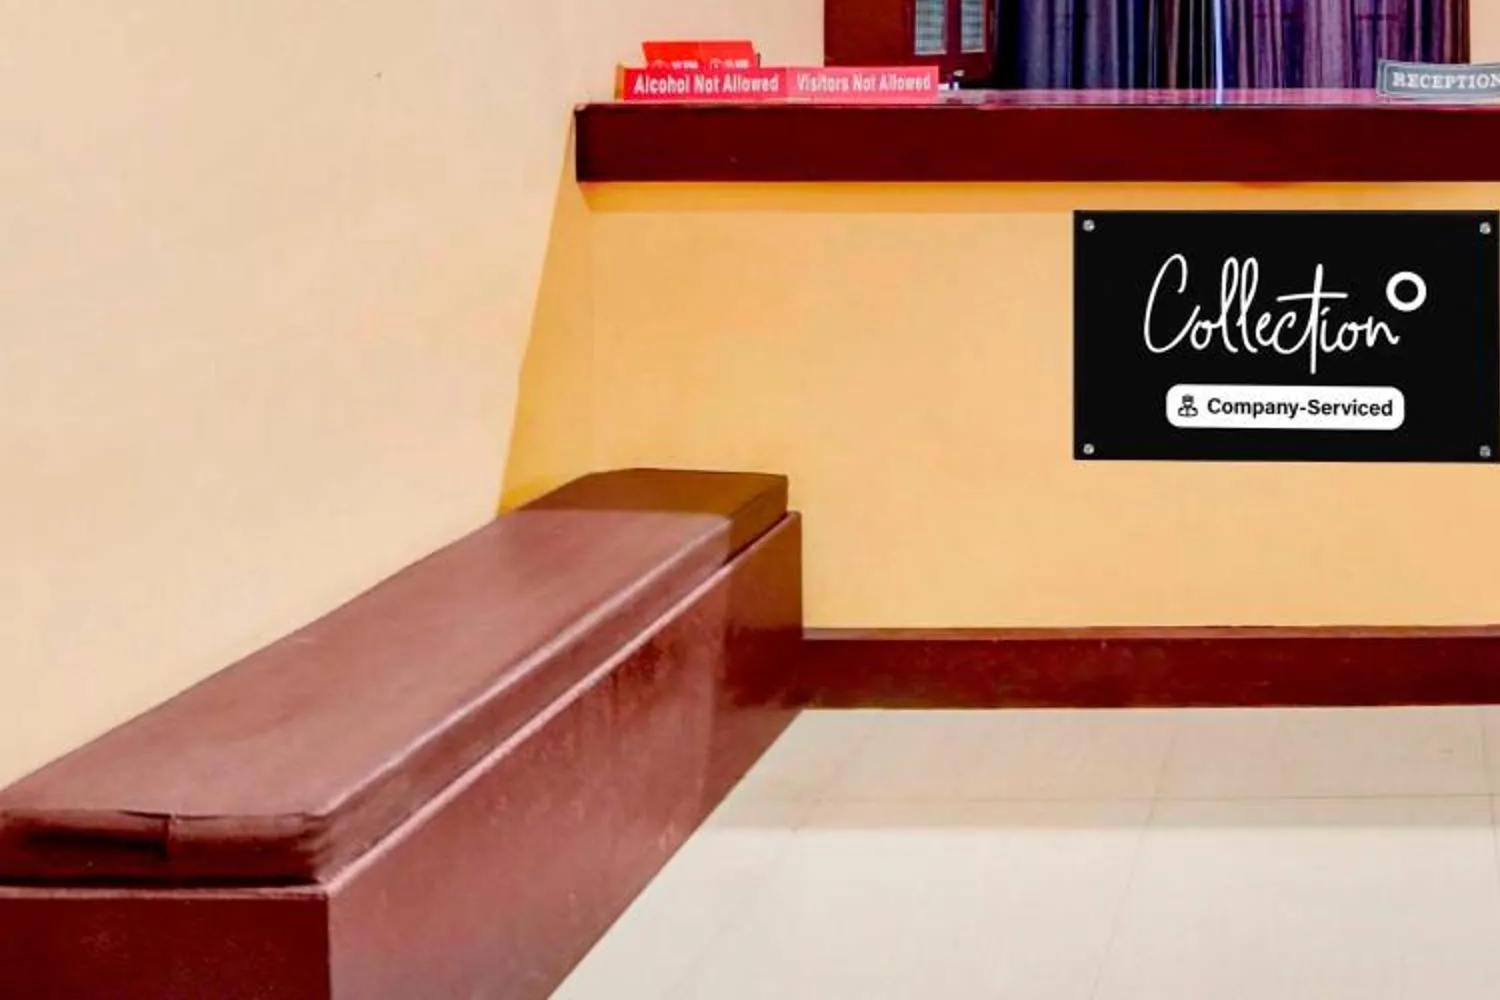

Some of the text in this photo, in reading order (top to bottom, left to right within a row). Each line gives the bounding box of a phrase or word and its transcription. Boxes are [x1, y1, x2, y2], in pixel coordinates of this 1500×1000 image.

[633, 72, 779, 94] Alcohol Not Allowed
[797, 71, 931, 91] Visitors Not Allowed
[1143, 253, 1400, 375] Collection
[1207, 397, 1393, 419] Company-Serviced
